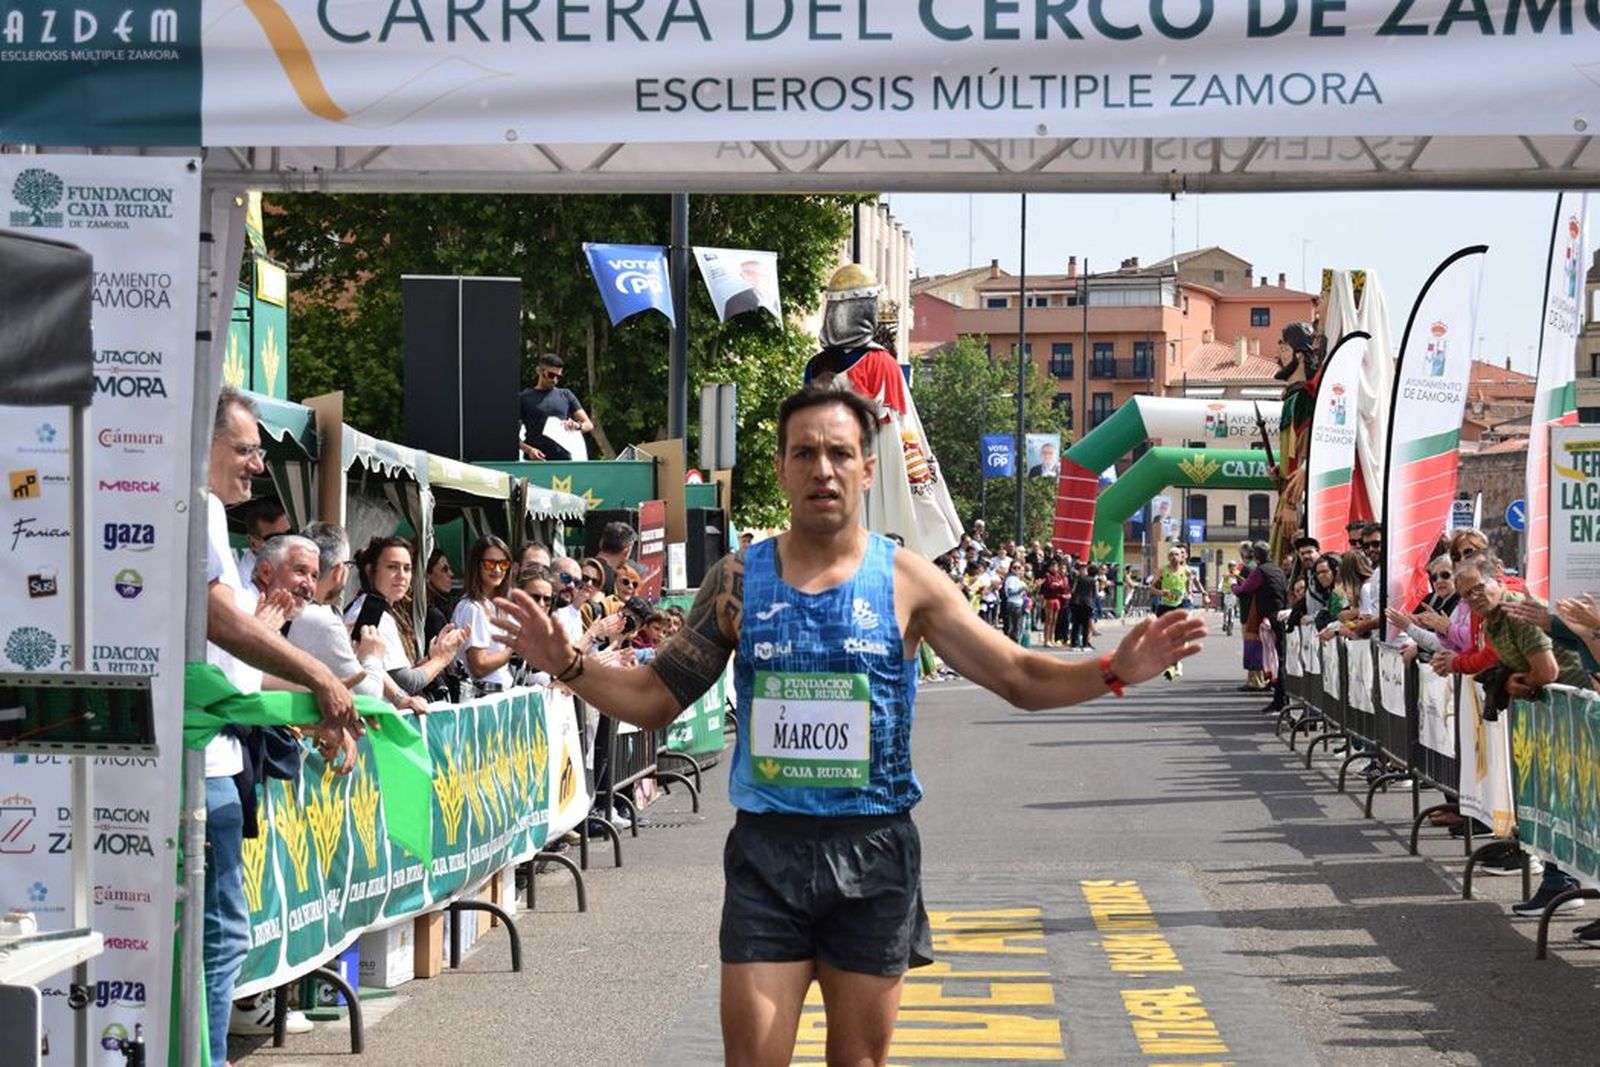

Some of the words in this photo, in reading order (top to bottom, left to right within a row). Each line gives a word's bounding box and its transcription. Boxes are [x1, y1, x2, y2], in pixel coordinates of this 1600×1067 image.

[317, 0, 713, 43] CARRERA
[745, 0, 893, 41] DEL
[918, 0, 1202, 42] CERCO
[1246, 0, 1347, 38] DE
[1376, 0, 1600, 37] ZAM
[1, 51, 69, 62] ESCLEROSIS
[71, 48, 126, 61] MÚLTIPLE
[128, 50, 179, 61] ZAMORA
[635, 75, 915, 113] ESCLEROSIS
[933, 66, 1153, 111] MÚLTIPLE
[1169, 71, 1383, 107] ZAMORA
[67, 186, 173, 203] FUNDACION
[67, 202, 110, 217] CAJA
[115, 203, 173, 219] RURAL
[87, 221, 129, 230] ZAMORA
[92, 272, 171, 289] TAMIENTO
[91, 289, 171, 309] AMORA
[91, 376, 167, 398] MORA
[1222, 460, 1268, 478] CAJA
[104, 523, 155, 550] gaza
[1570, 515, 1592, 542] EN
[784, 679, 853, 690] FUNDACION
[784, 688, 813, 699] CAJA
[814, 689, 853, 700] RURAL
[779, 705, 787, 721] 2
[773, 722, 850, 751] MARCOS
[782, 766, 814, 778] CAJA
[817, 767, 862, 779] RURAL
[96, 980, 146, 1008] gaza
